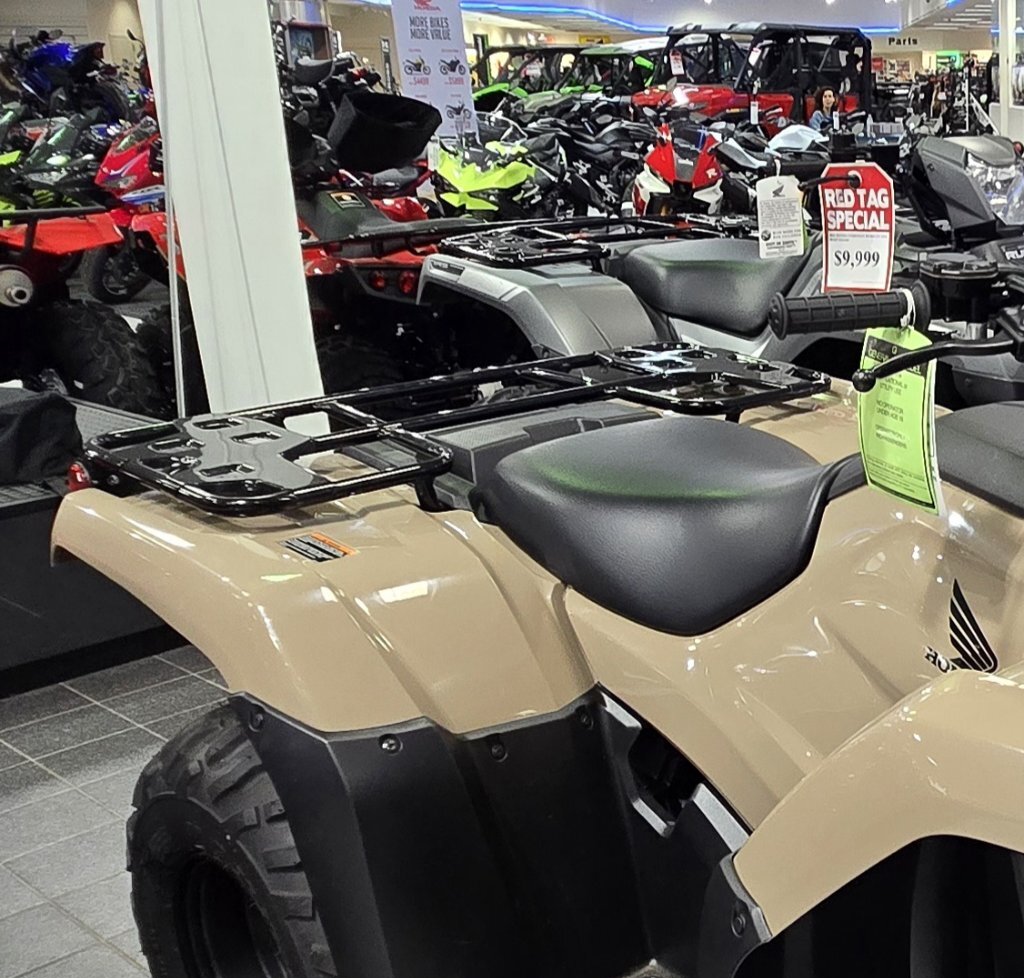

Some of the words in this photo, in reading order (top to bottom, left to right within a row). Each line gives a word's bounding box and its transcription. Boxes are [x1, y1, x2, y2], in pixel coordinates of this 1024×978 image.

[409, 16, 428, 30] MORE
[429, 16, 449, 28] BIKES
[410, 28, 429, 40] MORE
[430, 28, 451, 40] VALUE
[824, 188, 855, 208] RED
[856, 188, 889, 209] TAG
[827, 210, 890, 230] SPECIAL
[834, 250, 880, 270] $9,999
